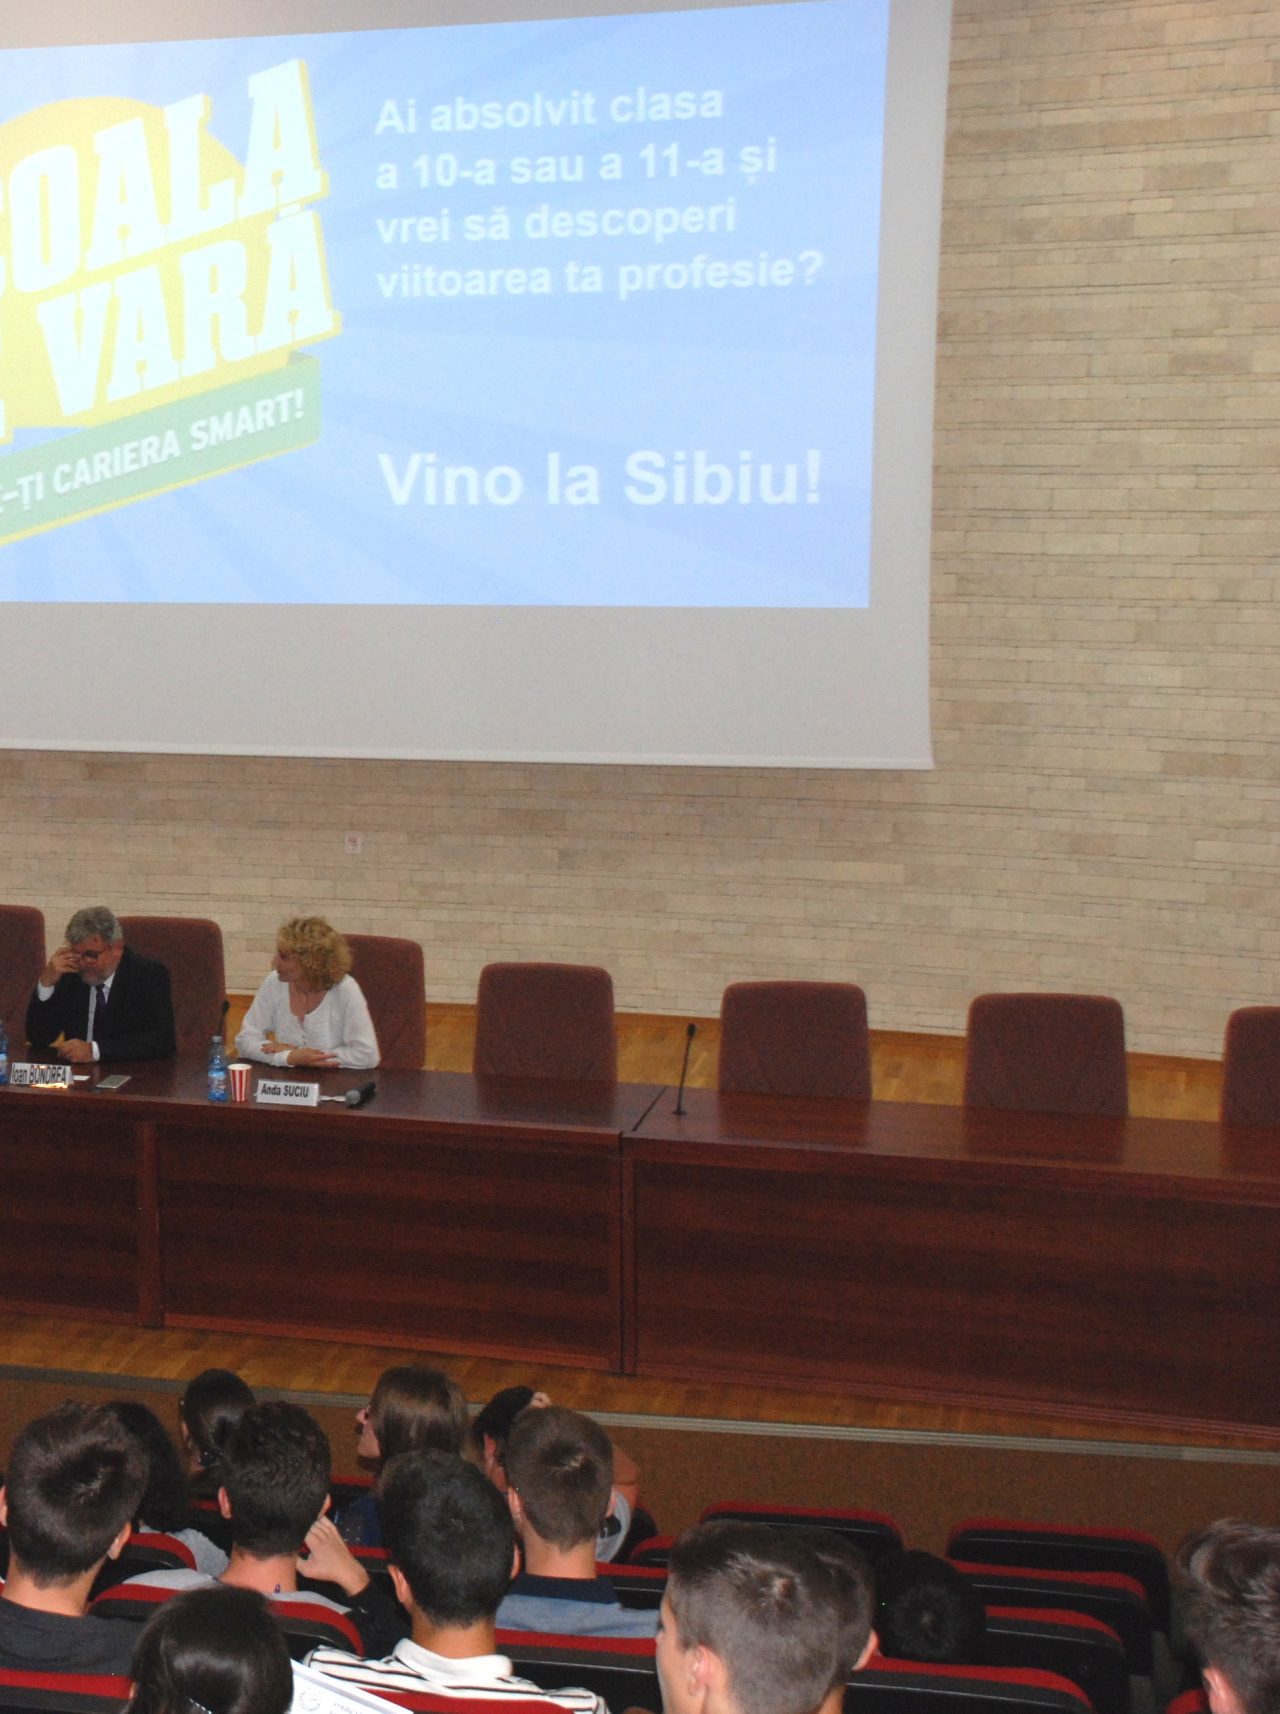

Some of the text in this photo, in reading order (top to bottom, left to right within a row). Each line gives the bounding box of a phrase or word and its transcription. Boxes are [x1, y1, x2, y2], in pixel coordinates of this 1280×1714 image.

[375, 86, 724, 136] Ai absolvit clasa
[376, 136, 777, 190] a 10-a sau a 11-a și
[376, 196, 737, 244] vrei să descoperi
[376, 249, 824, 301] viitoarea ta profesie?
[51, 427, 182, 497] CARIERA
[188, 387, 306, 455] SMART!
[378, 448, 822, 507] Vino la Sibiu!
[261, 1083, 310, 1098] Anda SUCIU
